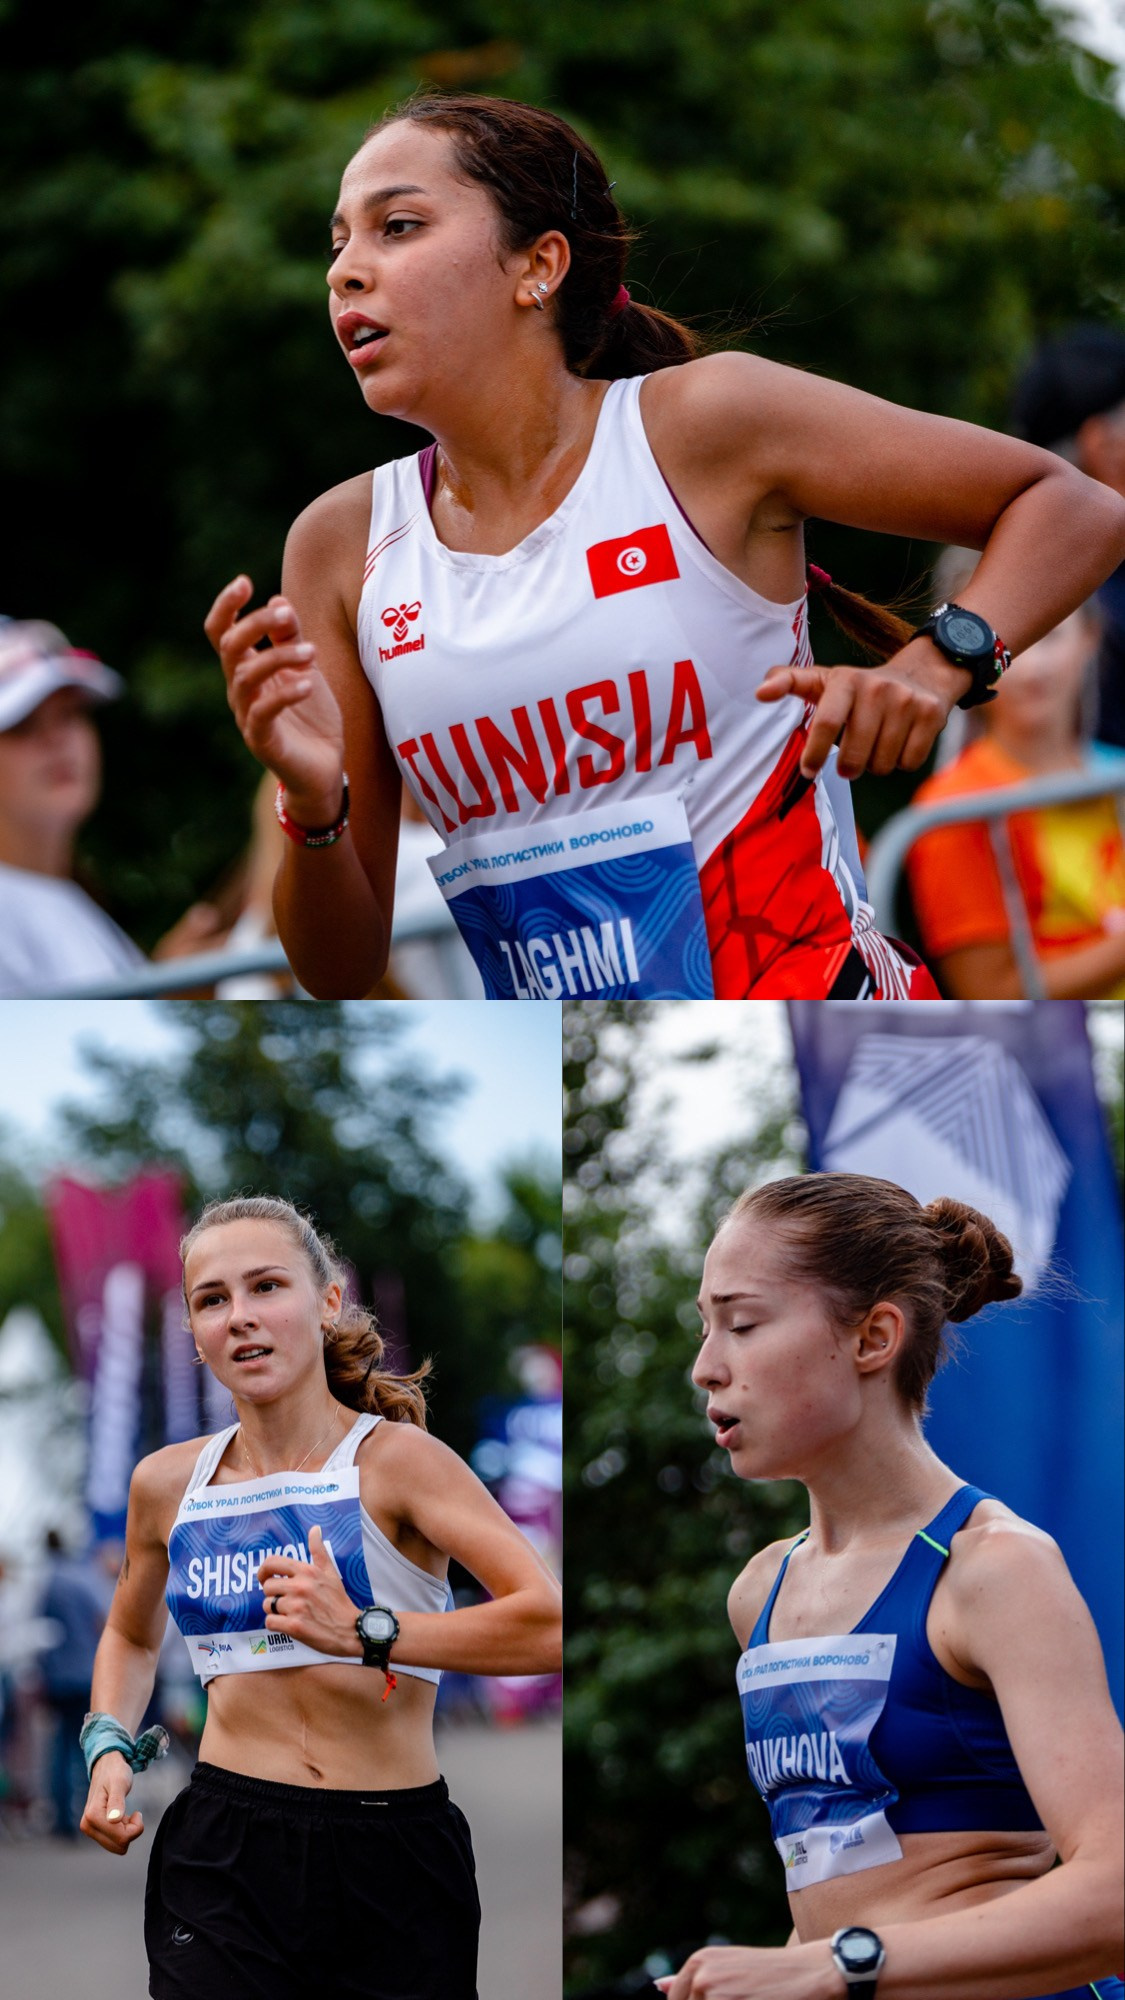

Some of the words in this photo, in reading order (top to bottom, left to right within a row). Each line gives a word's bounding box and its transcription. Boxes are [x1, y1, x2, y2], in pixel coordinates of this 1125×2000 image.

[378, 633, 425, 663] hummel
[397, 659, 713, 833] TUNISIA
[491, 841, 565, 868] ЛОГИСТИКИ
[569, 820, 654, 850] ВОРОНОВО
[499, 917, 640, 1000] ZAGHMI
[215, 1499, 239, 1509] УРАЛ
[240, 1488, 283, 1505] ЛОГИСТИКИ
[284, 1484, 339, 1495] ВОРОНОВО
[267, 1633, 293, 1646] URAL
[269, 1644, 295, 1653] LOGISTICS
[813, 1654, 870, 1666] ВОРОНОВО
